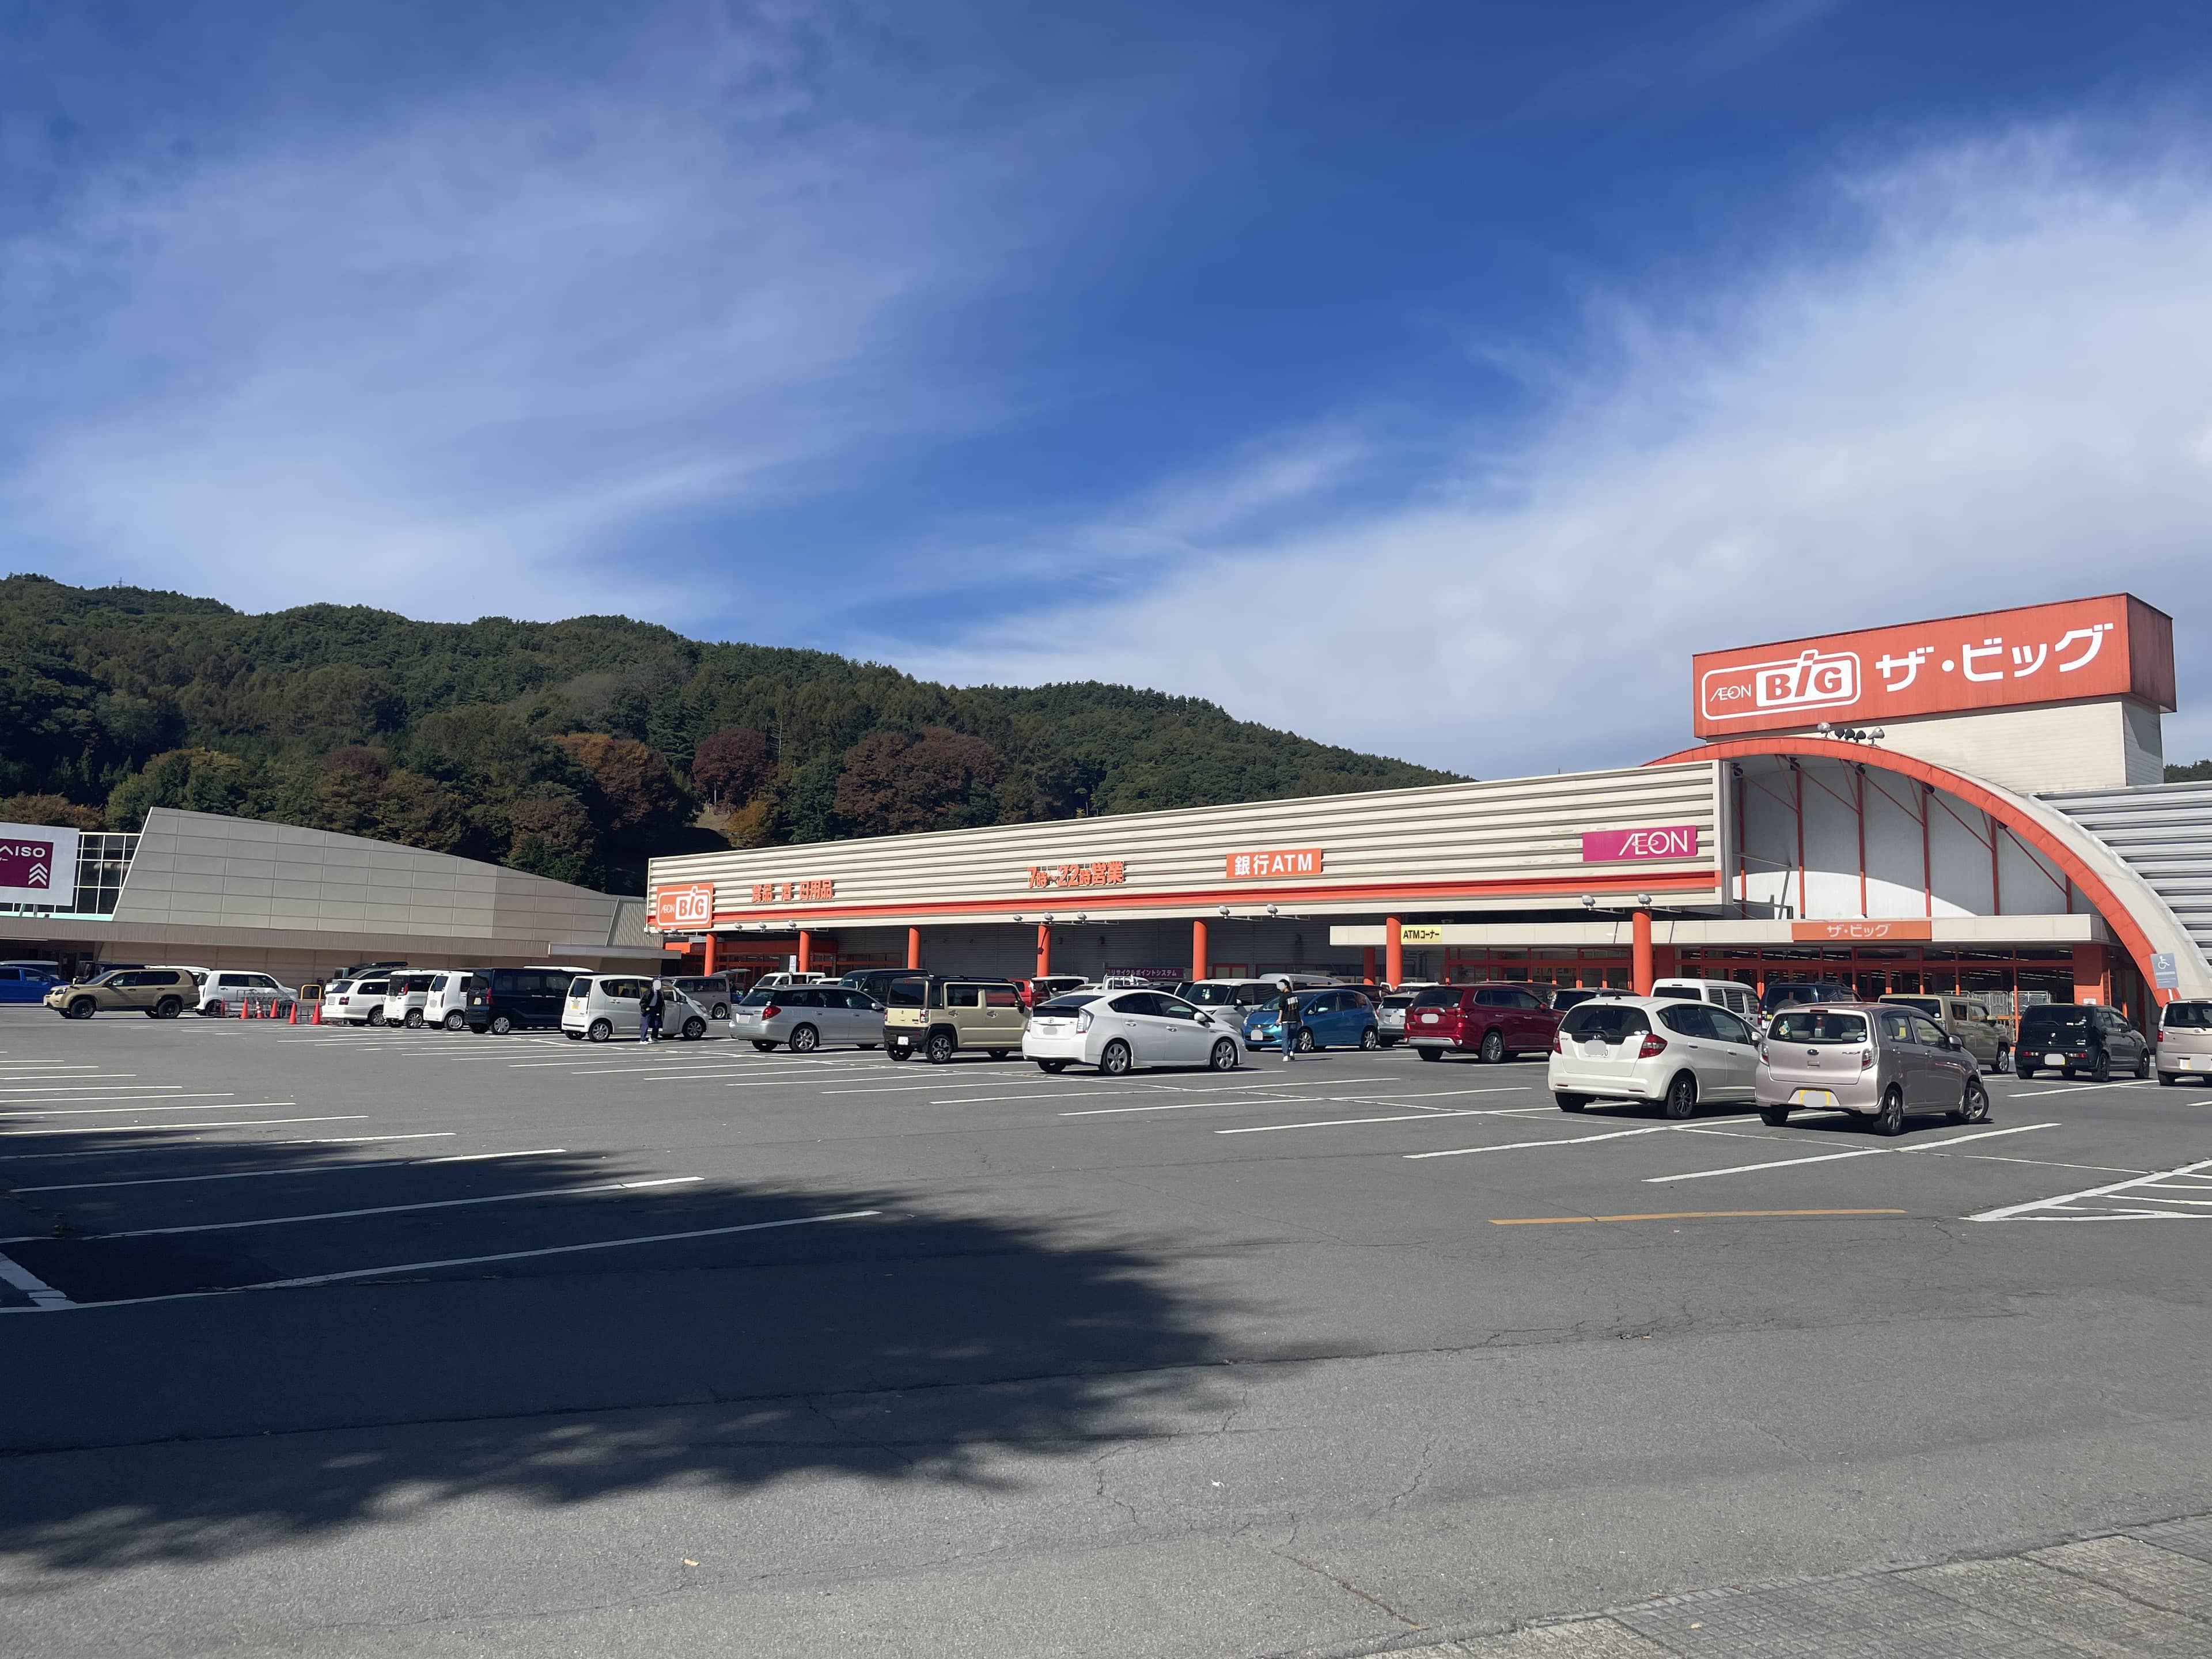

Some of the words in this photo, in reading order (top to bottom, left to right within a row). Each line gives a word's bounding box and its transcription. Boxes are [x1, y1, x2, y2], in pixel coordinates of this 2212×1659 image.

[1874, 622, 2114, 692] ザ・ビッグ
[1234, 853, 1312, 876] 銀行ATM
[751, 884, 772, 903] 食品
[782, 882, 791, 901] 酒
[800, 879, 833, 900] 日用品
[1403, 929, 1440, 939] ATMコーナー
[1827, 923, 1892, 938] ザ・ビッグ
